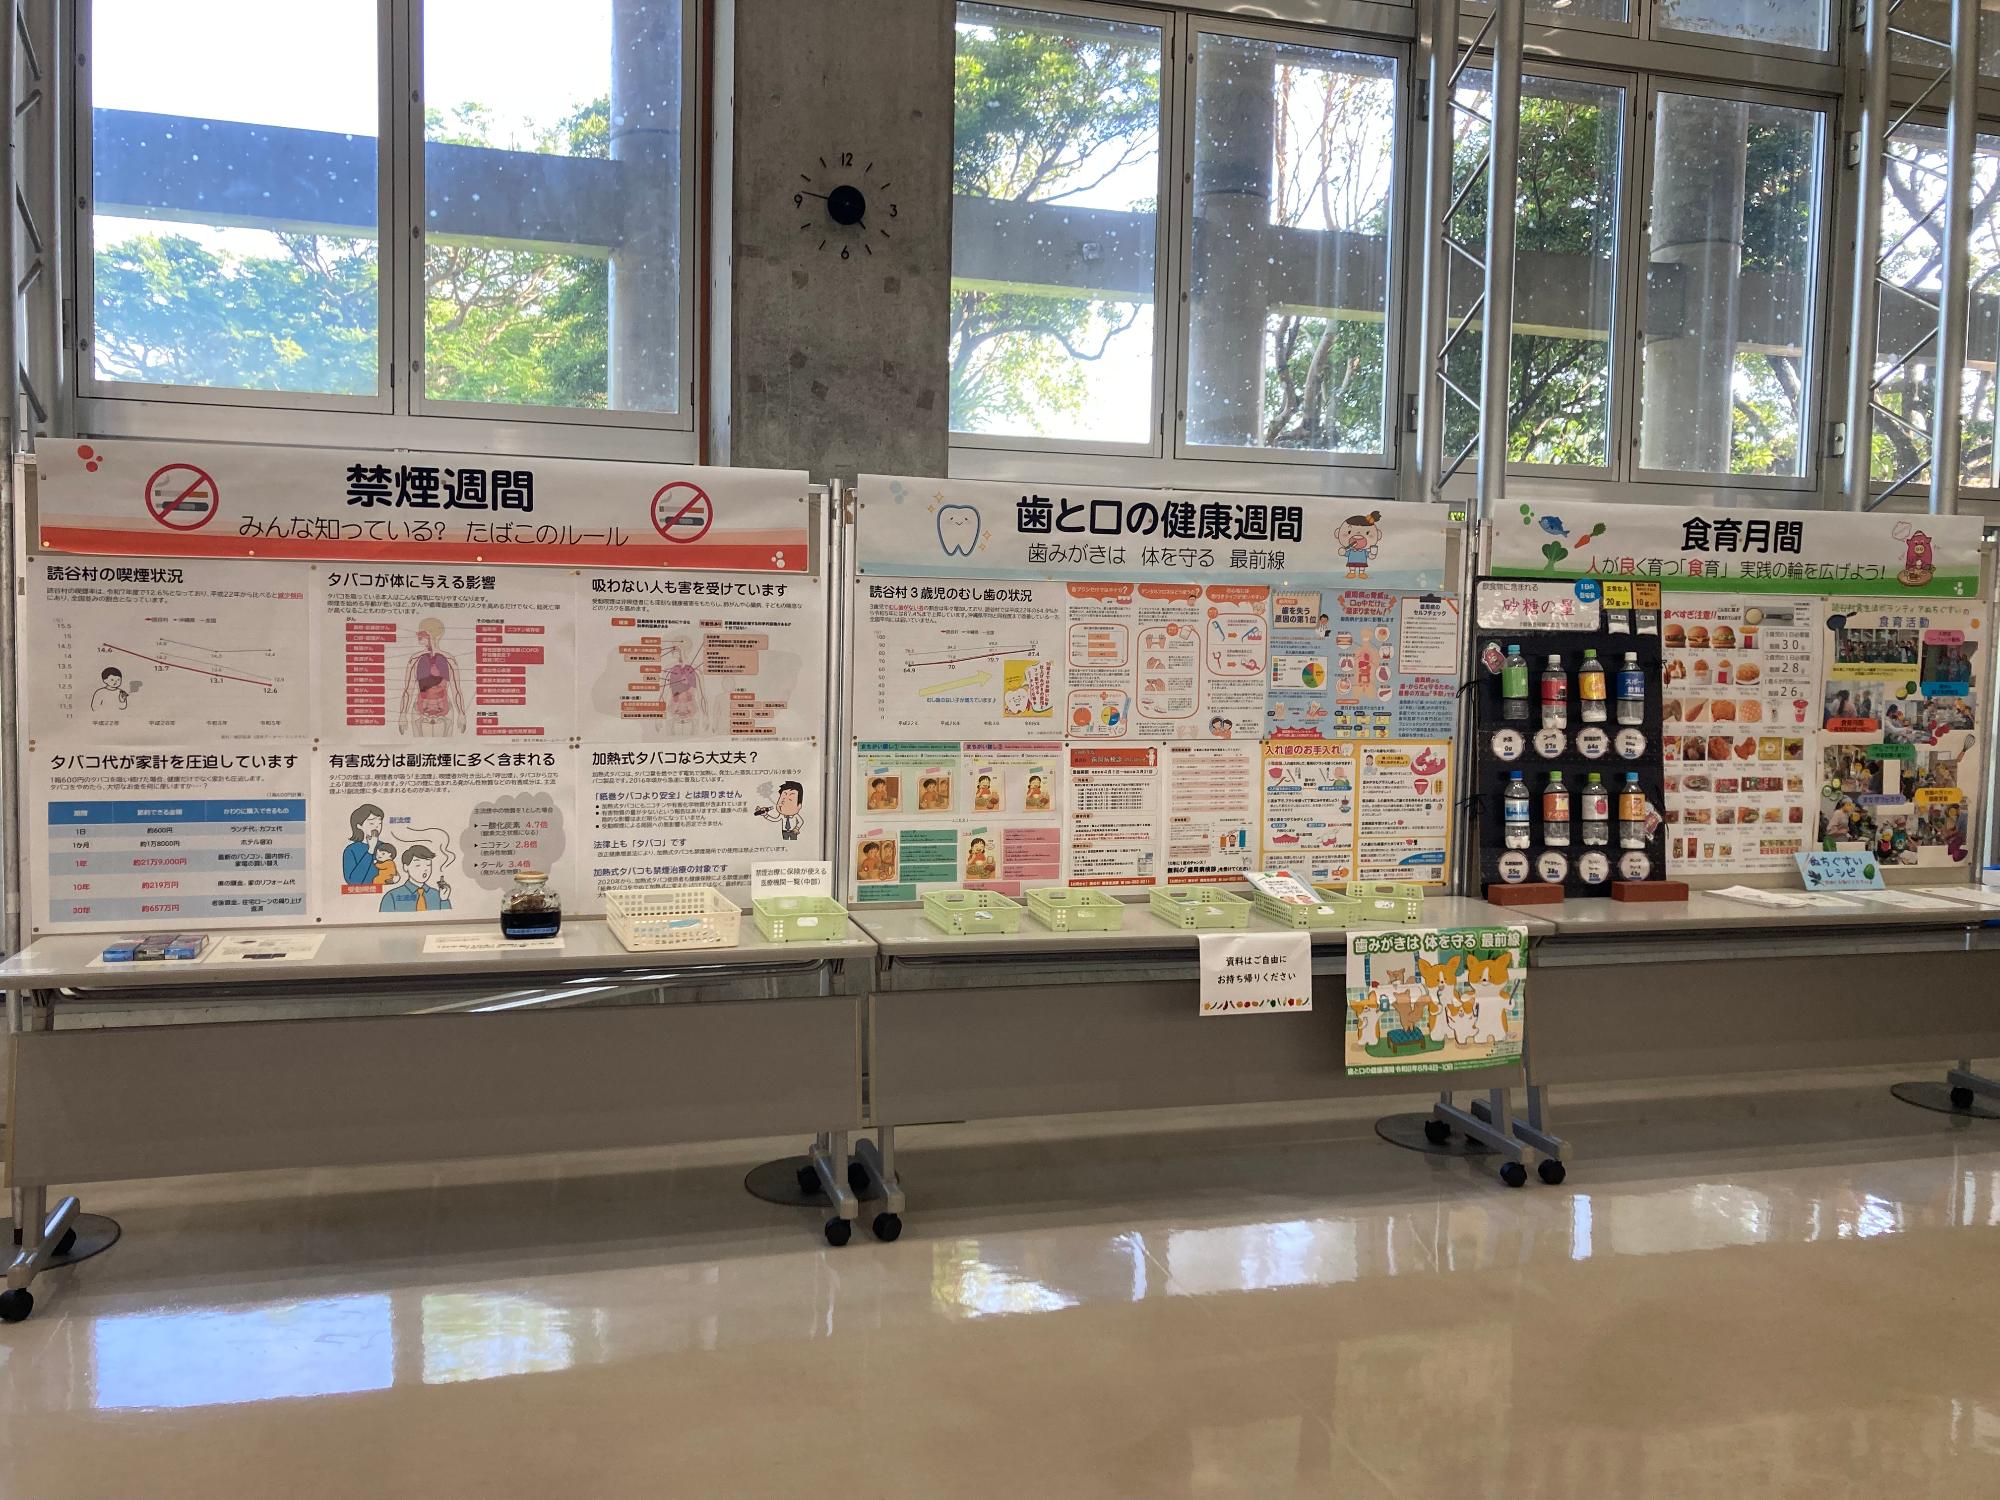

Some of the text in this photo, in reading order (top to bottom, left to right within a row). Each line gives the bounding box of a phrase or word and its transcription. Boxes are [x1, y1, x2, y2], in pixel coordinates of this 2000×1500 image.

[841, 152, 853, 167] 12
[794, 193, 803, 208] 9
[889, 204, 898, 217] 3
[841, 245, 850, 260] 6
[346, 463, 534, 512] 禁煙週間
[1016, 494, 1303, 543] 歯と口の健康週間
[466, 519, 629, 547] たばこのルール
[1681, 516, 1803, 554] 食育月間
[1028, 543, 1286, 570] 歯みがきは 体を守る 最前線
[1585, 556, 1728, 578] 人が良く育つ「食育」
[47, 565, 184, 584] 読谷村の喫煙状況
[327, 572, 496, 590] タバコが体に与える影響
[592, 578, 788, 597] 吸わない人も害を受けています
[1482, 583, 1539, 592] 飲食物に含まれる
[1281, 606, 1311, 615] 歯を失う
[1274, 615, 1317, 624] 原因の第1位
[1782, 639, 1800, 650] 30
[1781, 662, 1800, 673] 28
[1779, 686, 1798, 697] 26
[49, 753, 299, 770] タバコ代が家計を圧迫しています
[329, 752, 556, 769] 有害成分は副流煙に多く含まれる
[223, 807, 290, 815] かわりに購入できるもの
[75, 825, 283, 836] 1日 約600円 ランチ代、カフェ代
[480, 820, 549, 830] 一酸化炭素 4.7倍
[72, 841, 90, 849] 1か月
[139, 840, 181, 848] 約1万8000円
[480, 840, 538, 849] ニコチン 2.8倍
[593, 838, 686, 849] 法律上も「タバコ」です
[75, 859, 88, 868] 1年
[480, 860, 531, 868] タール 3.4倍
[1810, 856, 1863, 867] ぬちぐすい
[593, 863, 729, 877] 加熱式タバコも禁煙治療の対象です
[755, 867, 828, 877] 禁煙治療に保険が使える
[1825, 868, 1856, 878] レシピ
[72, 882, 90, 891] 10年
[141, 880, 179, 890] 約219万円
[72, 906, 91, 915] 30年
[141, 904, 180, 914] 約657万円
[1354, 931, 1521, 953] 歯みがきは 体を守る 最前線
[1225, 954, 1287, 966] 資料はご自由に
[1217, 971, 1296, 984] お持ち帰りください
